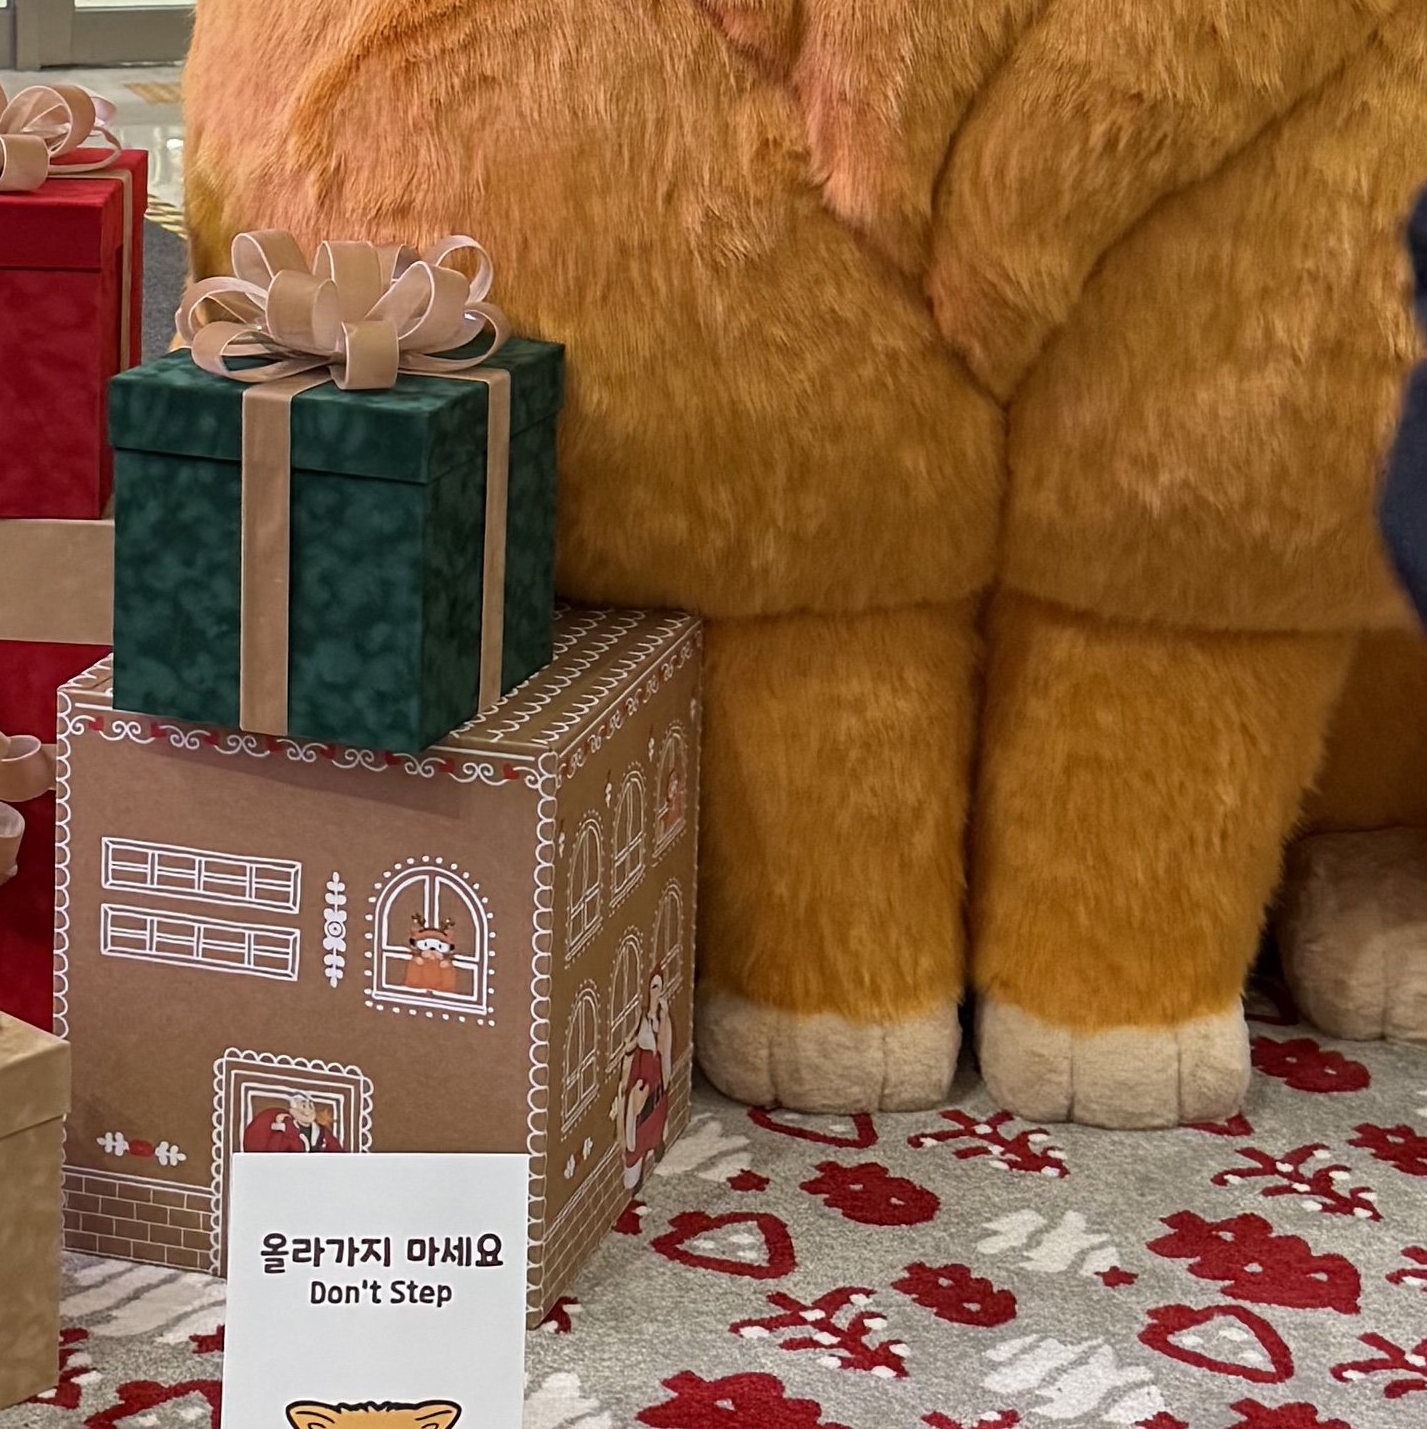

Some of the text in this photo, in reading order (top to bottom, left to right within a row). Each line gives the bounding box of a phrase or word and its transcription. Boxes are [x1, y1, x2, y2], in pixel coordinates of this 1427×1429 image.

[260, 1233, 505, 1274] 올라가지 마세요
[310, 1280, 453, 1308] Don't Step
